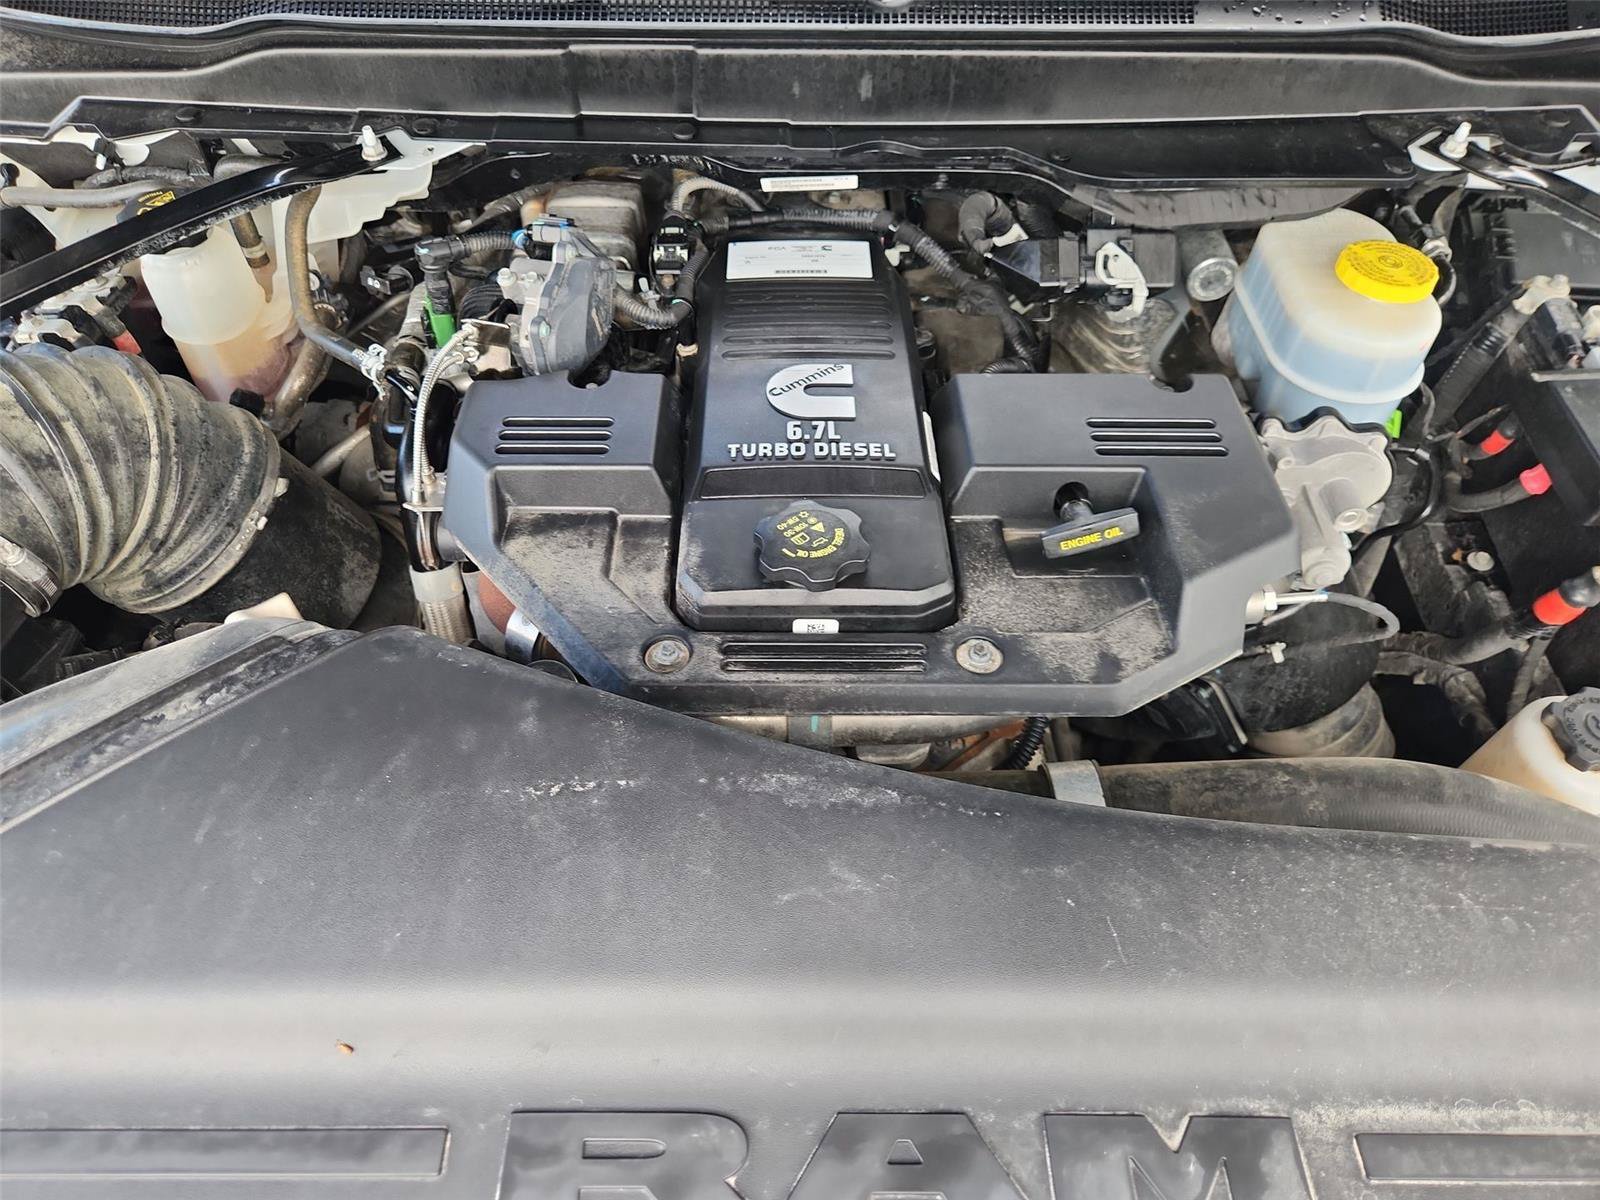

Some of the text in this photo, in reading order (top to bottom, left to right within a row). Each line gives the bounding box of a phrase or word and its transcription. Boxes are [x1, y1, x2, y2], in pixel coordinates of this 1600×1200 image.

[769, 363, 844, 396] Cummins
[786, 420, 842, 442] 6.7L
[727, 442, 898, 461] TURBO DIESEL
[1060, 527, 1123, 550] ENGINE OIL
